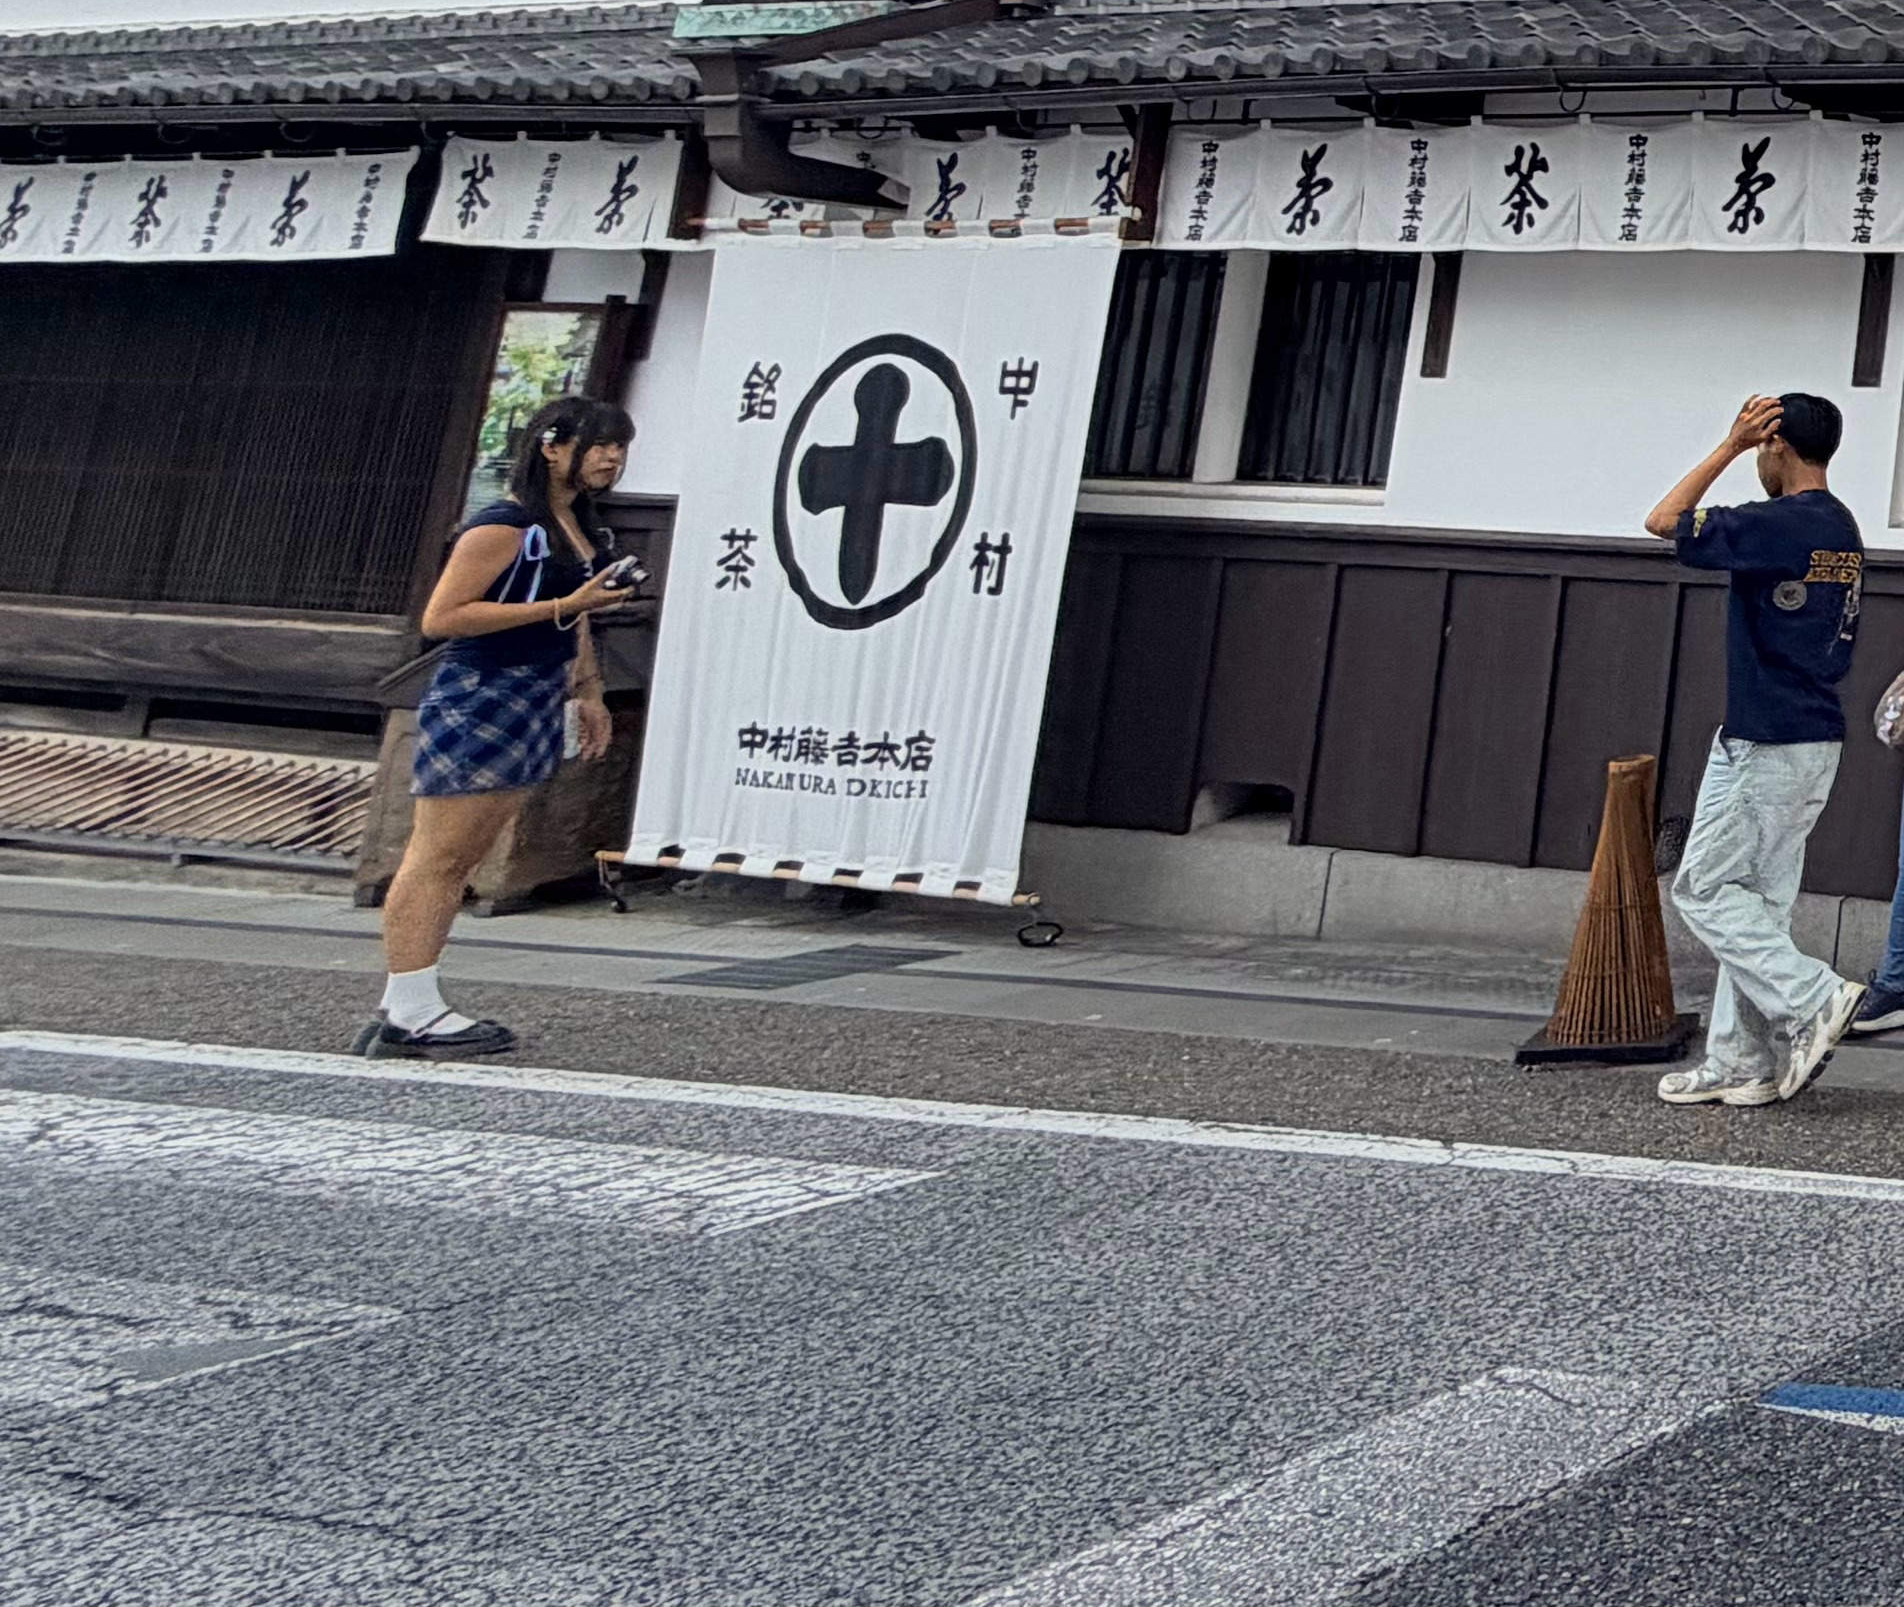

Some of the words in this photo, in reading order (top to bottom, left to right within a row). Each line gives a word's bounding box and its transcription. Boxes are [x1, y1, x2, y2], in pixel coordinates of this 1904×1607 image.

[128, 170, 174, 247] 茶
[450, 150, 494, 228] 茶
[1282, 143, 1333, 235] 茶
[1500, 142, 1549, 234] 茶
[1722, 136, 1775, 234] 茶
